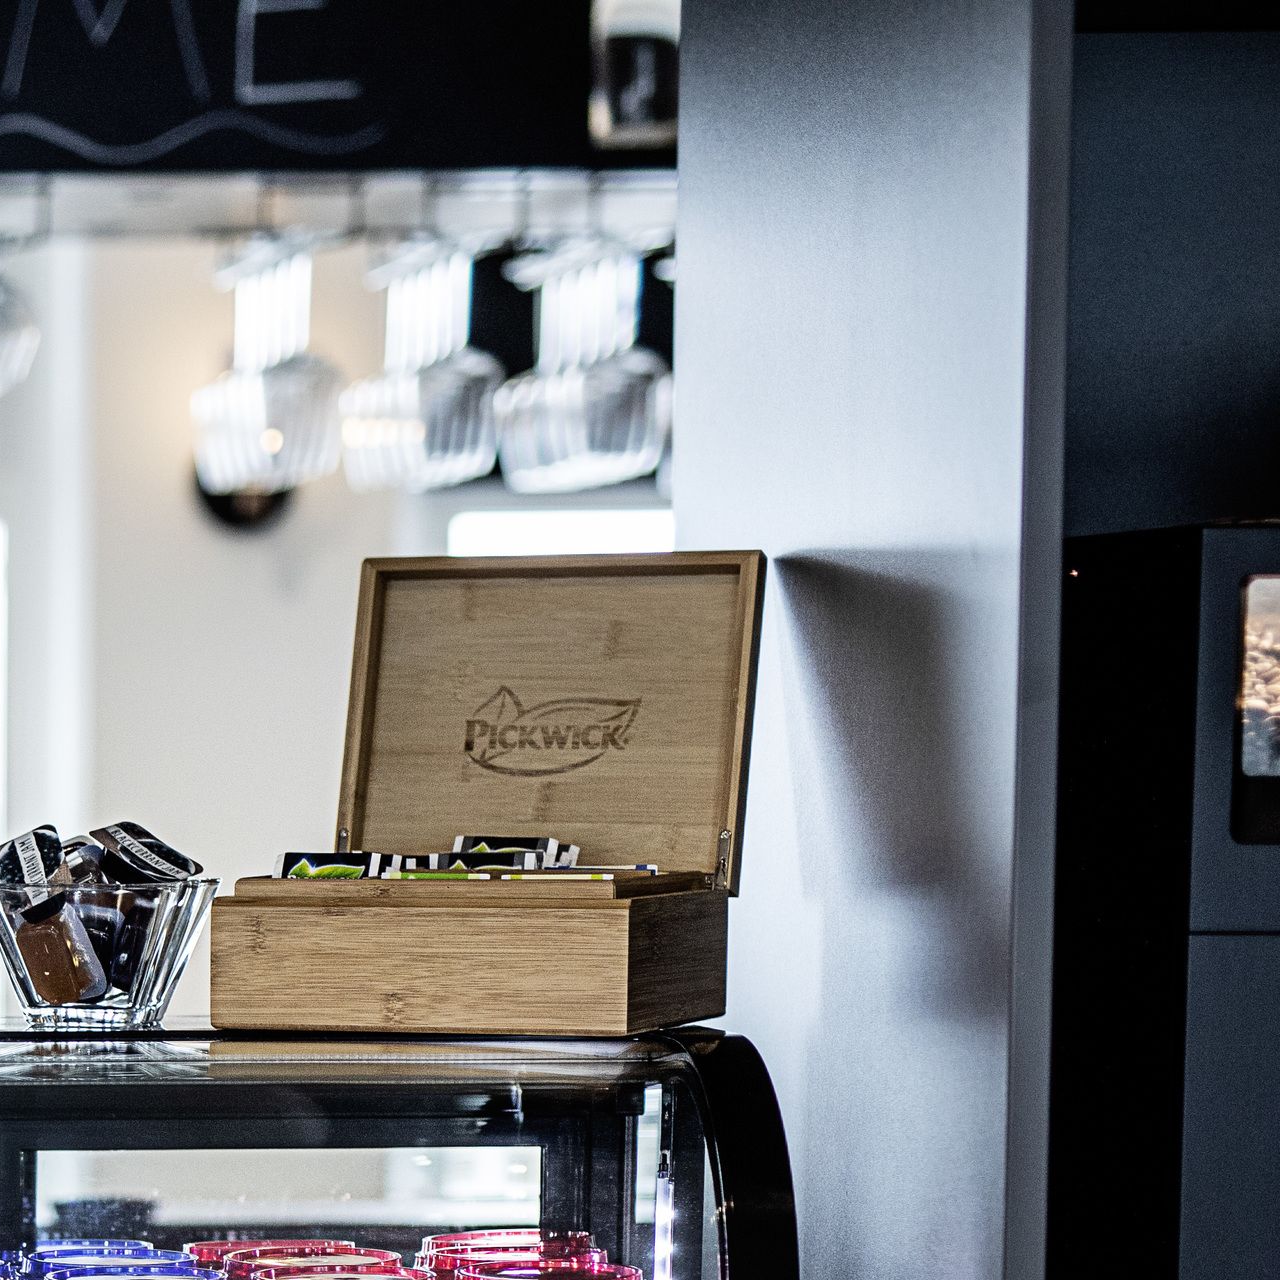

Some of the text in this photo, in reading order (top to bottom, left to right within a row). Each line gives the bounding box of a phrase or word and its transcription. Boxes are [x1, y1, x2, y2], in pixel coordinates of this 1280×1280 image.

[464, 719, 626, 752] PICKWICK
[112, 828, 184, 880] BLACKCURRANT JAM
